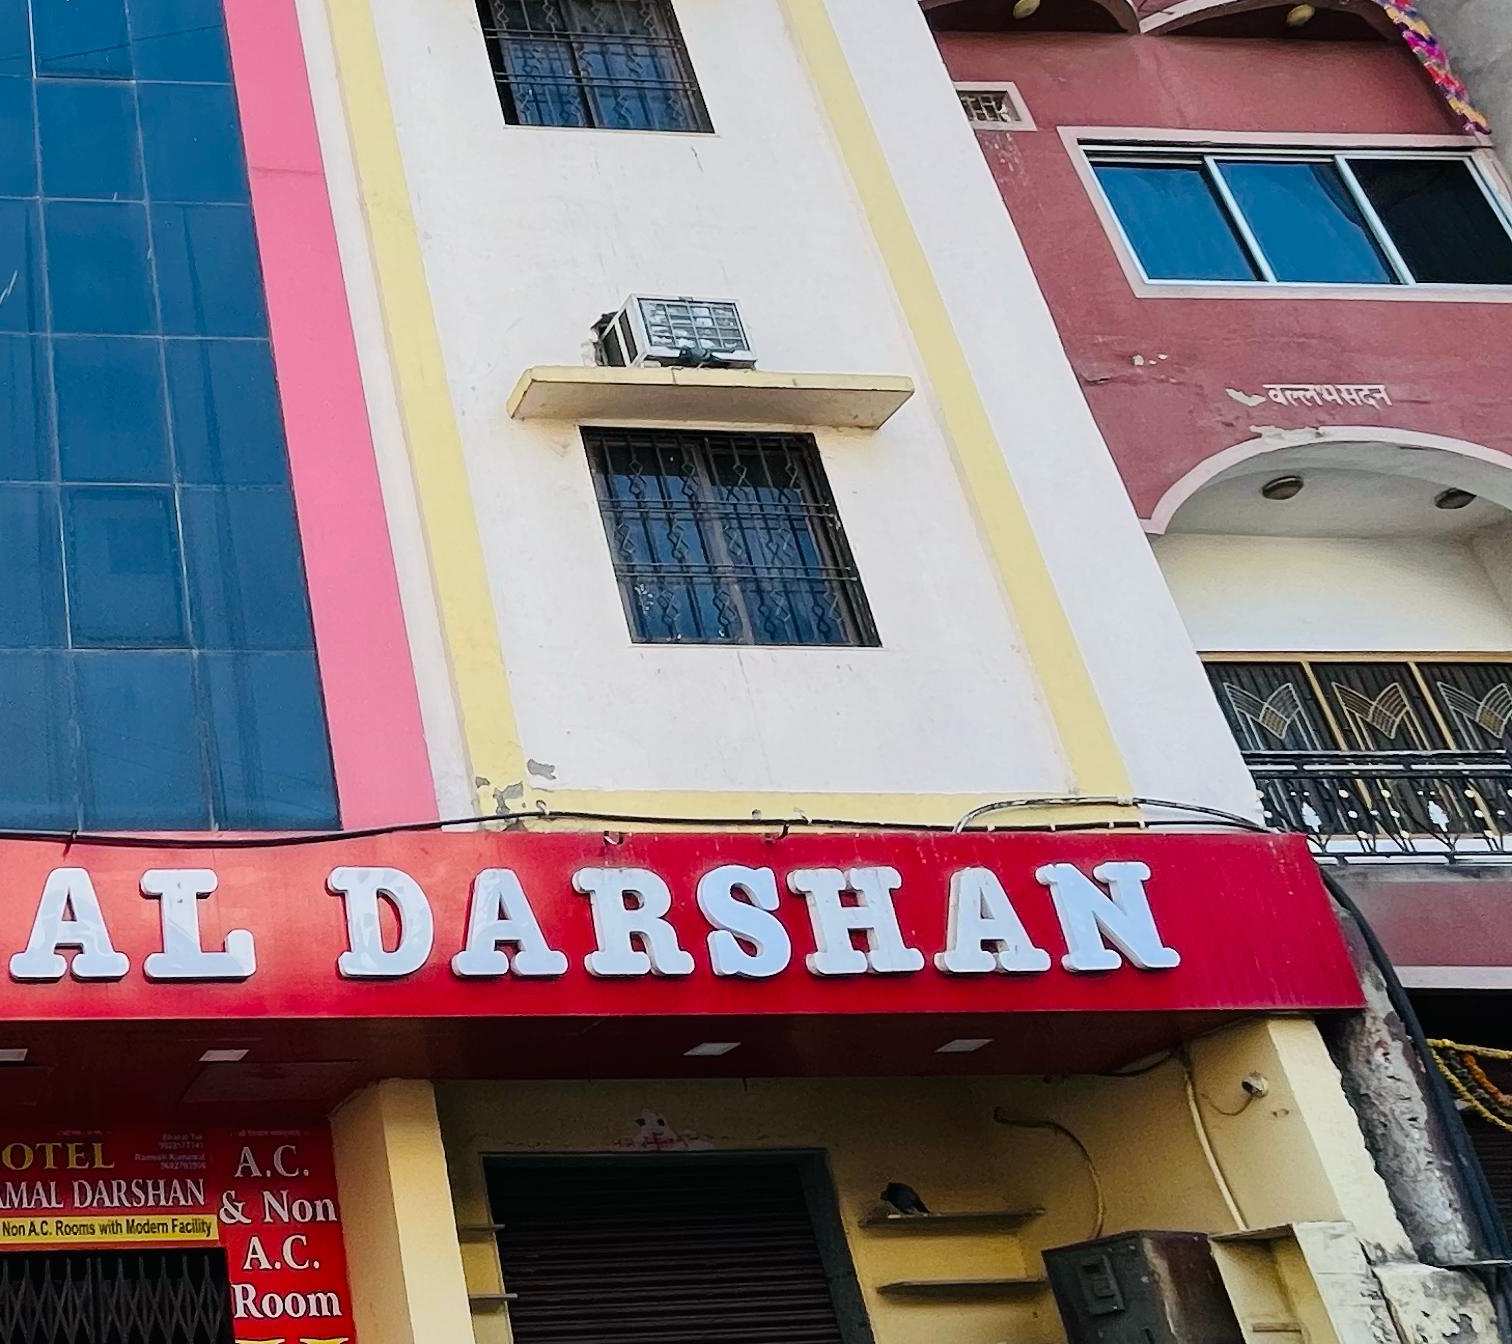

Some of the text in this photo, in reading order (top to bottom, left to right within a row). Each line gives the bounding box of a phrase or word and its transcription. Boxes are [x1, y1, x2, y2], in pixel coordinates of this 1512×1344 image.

[325, 860, 1183, 979] DARSHAN
[234, 1144, 310, 1178] A.C.
[71, 1178, 205, 1208] DARSHAN
[219, 1189, 338, 1224] & Non
[2, 1220, 26, 1237] Non
[28, 1220, 53, 1237] A.C.
[55, 1220, 96, 1236] Rooms
[99, 1218, 123, 1235] with
[126, 1218, 169, 1235] Modern
[171, 1217, 212, 1238] Facility
[242, 1234, 321, 1270] A.C.
[231, 1283, 343, 1319] Room
